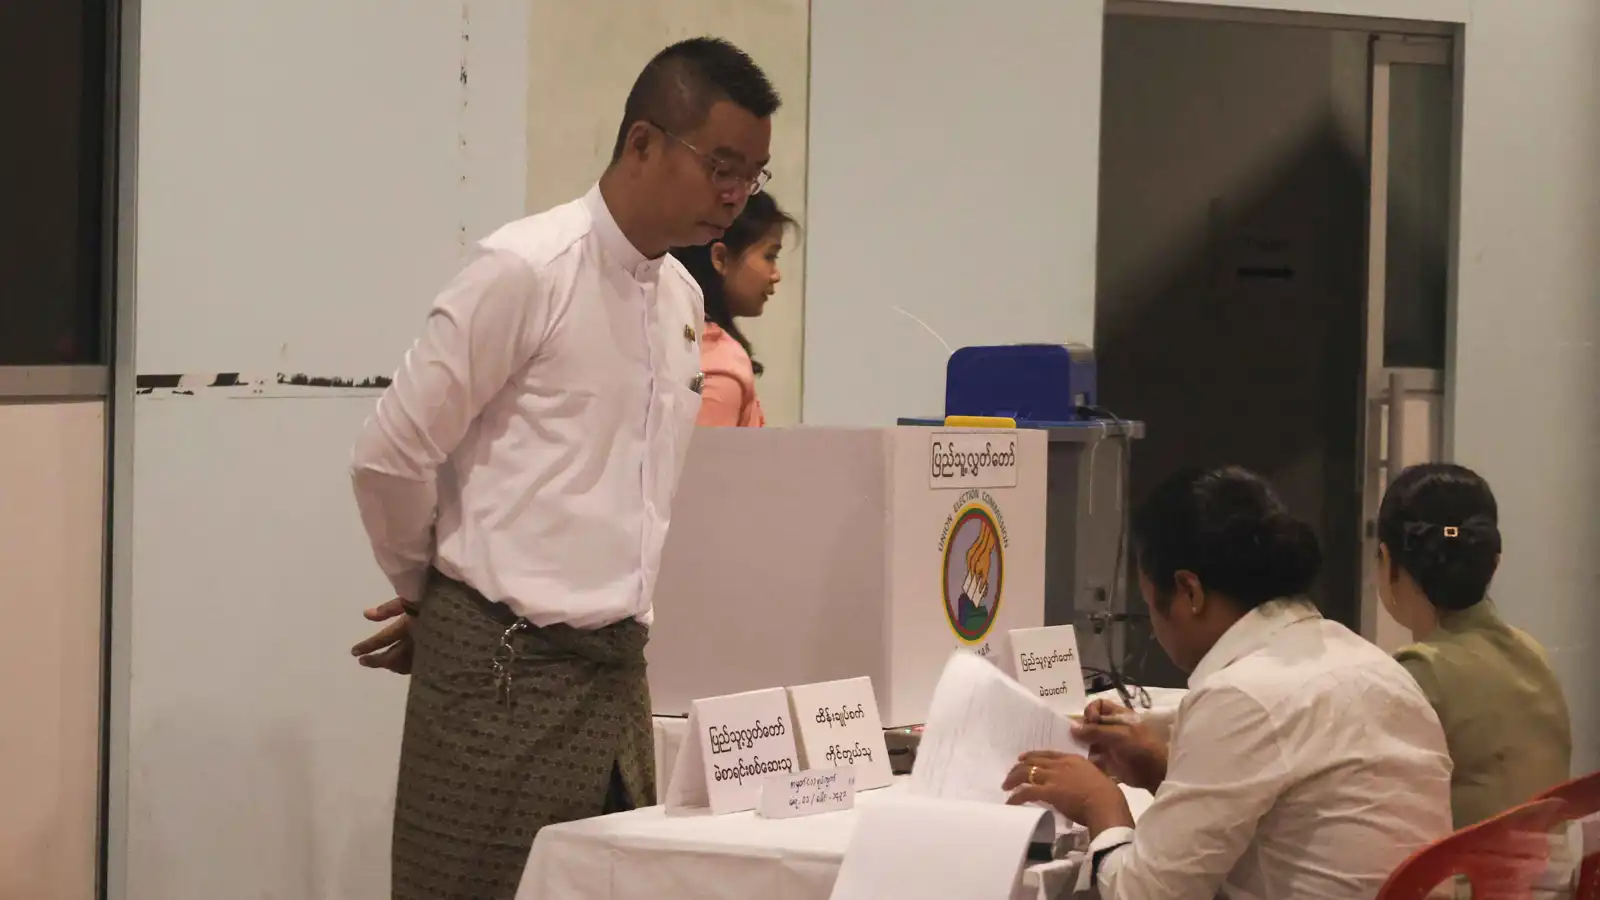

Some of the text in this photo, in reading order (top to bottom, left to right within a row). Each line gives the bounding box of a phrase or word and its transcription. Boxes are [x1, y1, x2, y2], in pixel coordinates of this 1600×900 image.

[938, 488, 1009, 552] UNION ELECTION COMMISSION
